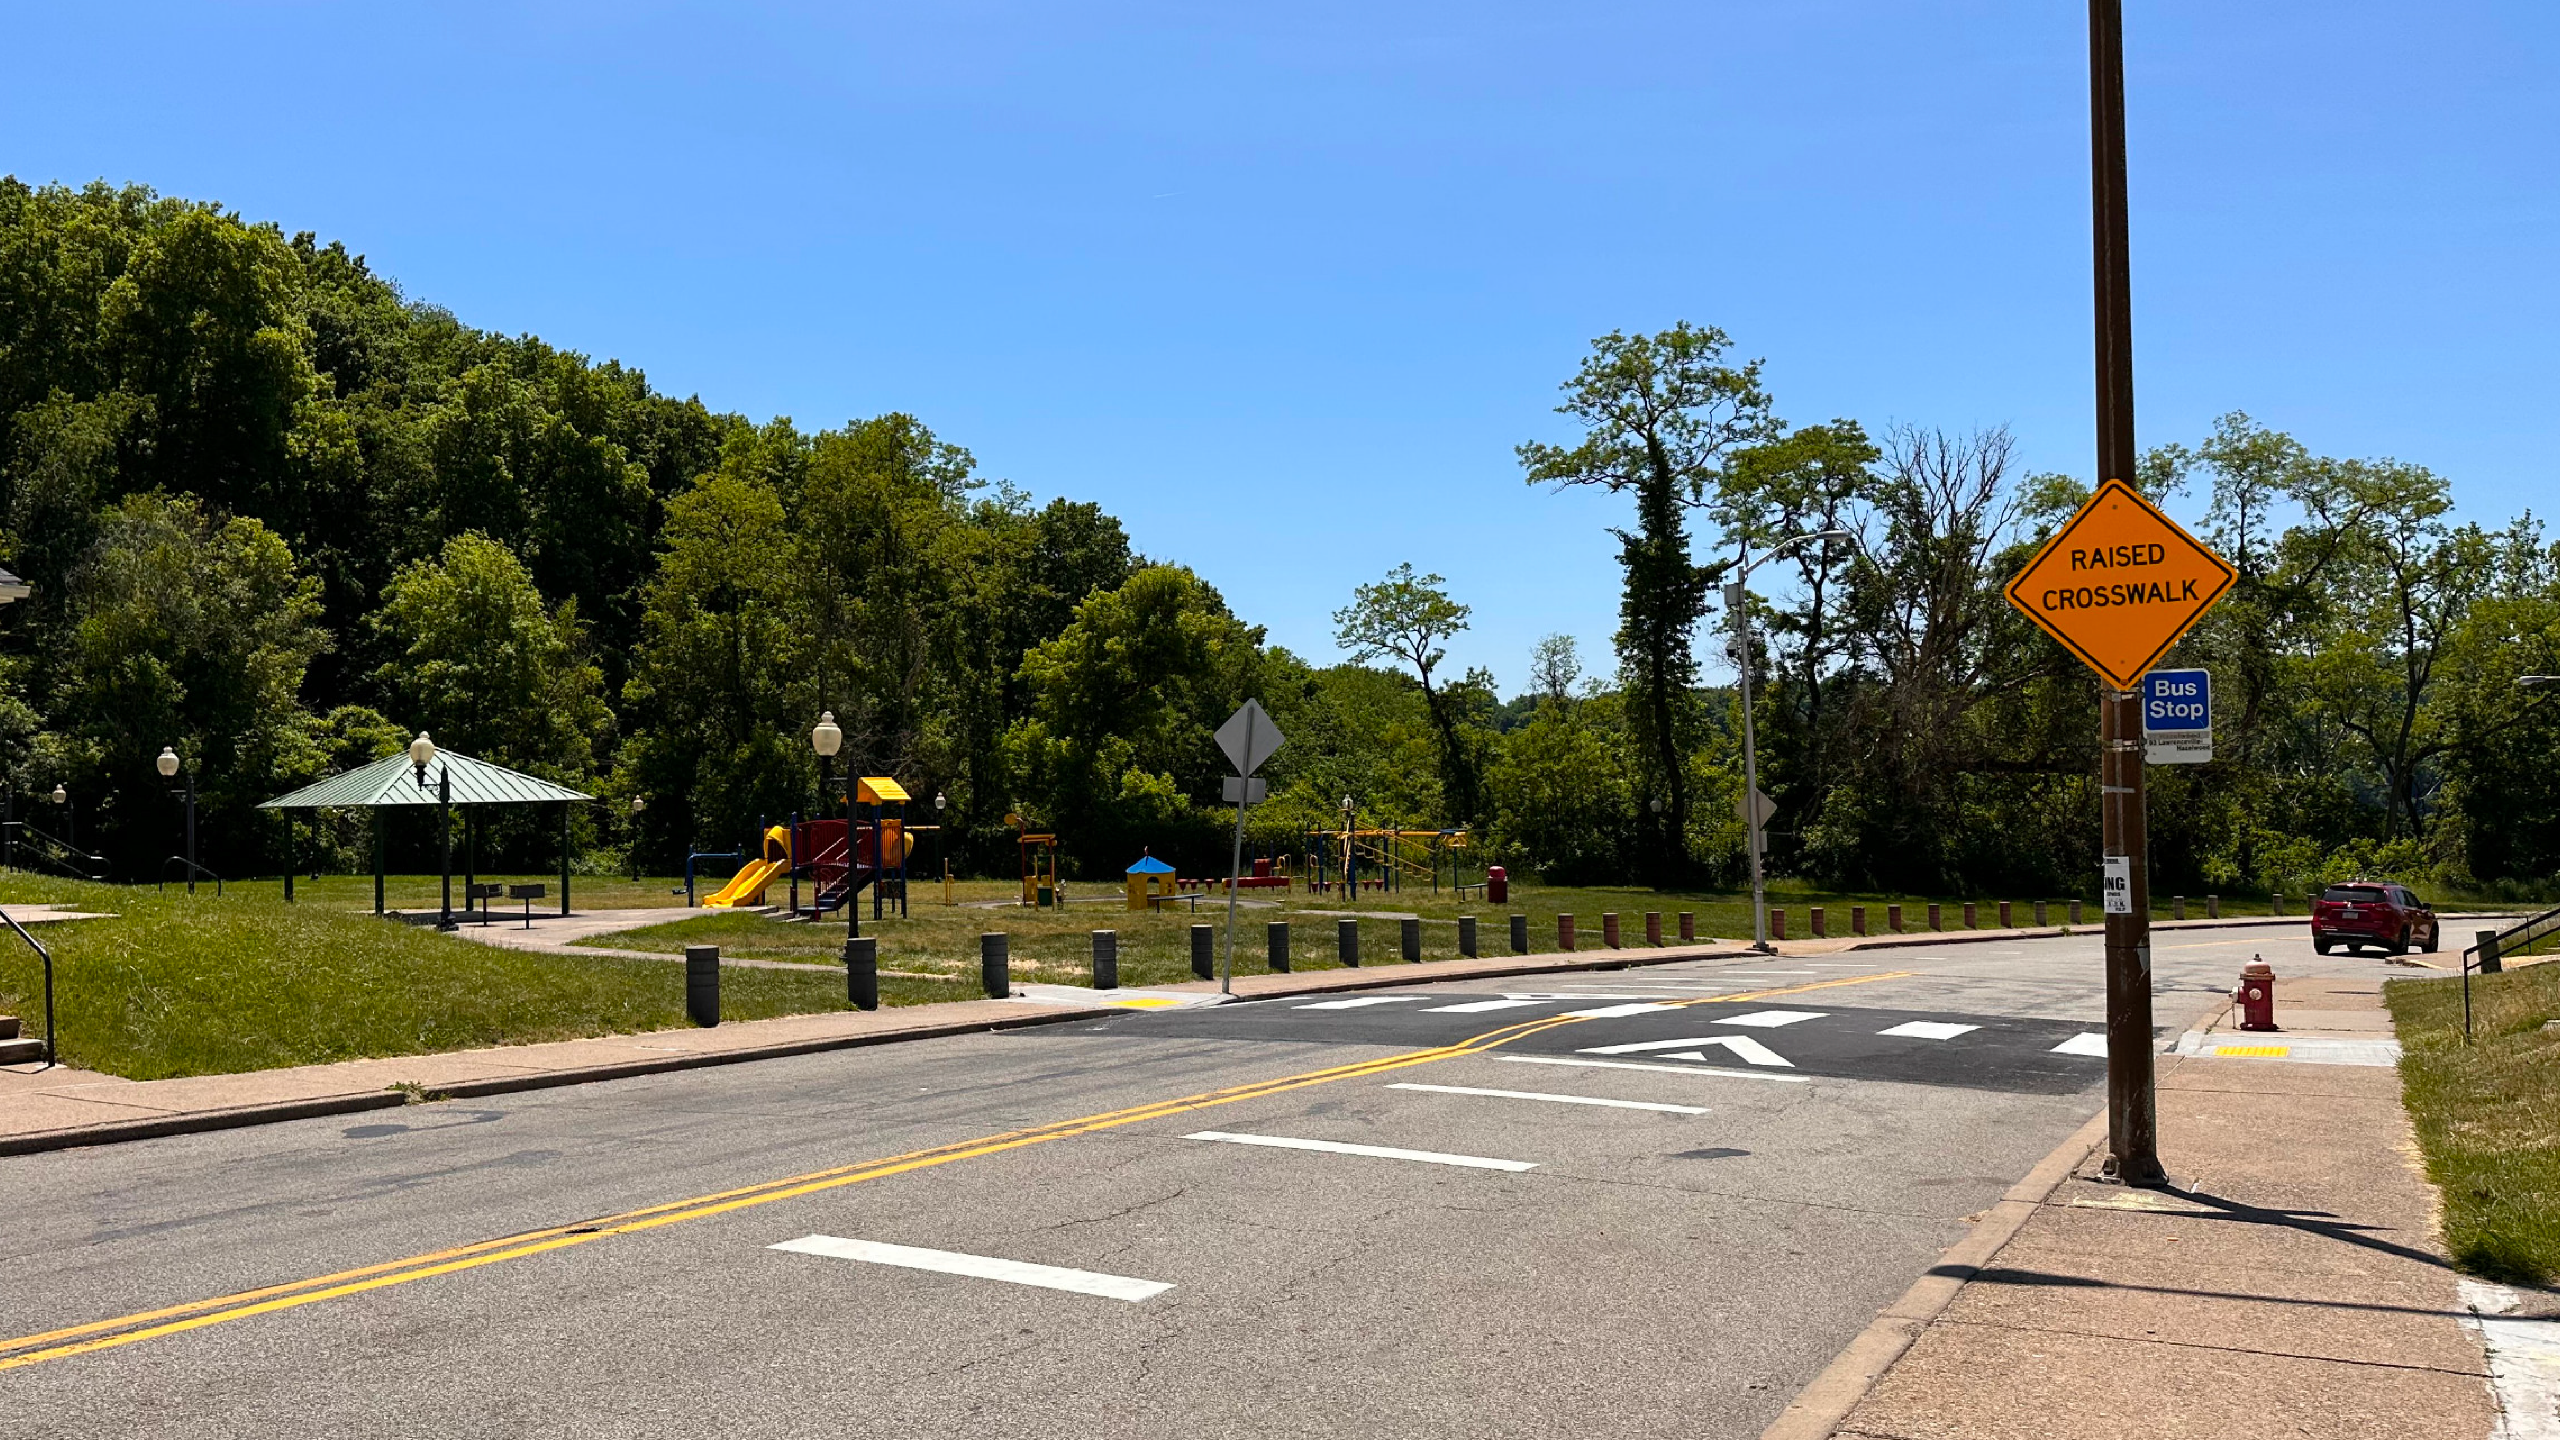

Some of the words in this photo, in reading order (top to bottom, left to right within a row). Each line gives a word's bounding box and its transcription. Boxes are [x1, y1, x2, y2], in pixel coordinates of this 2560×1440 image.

[2071, 543, 2165, 571] RAISED
[2042, 578, 2200, 611] CROSSWALK
[2155, 680, 2197, 696] Bus
[2149, 700, 2204, 720] Stop
